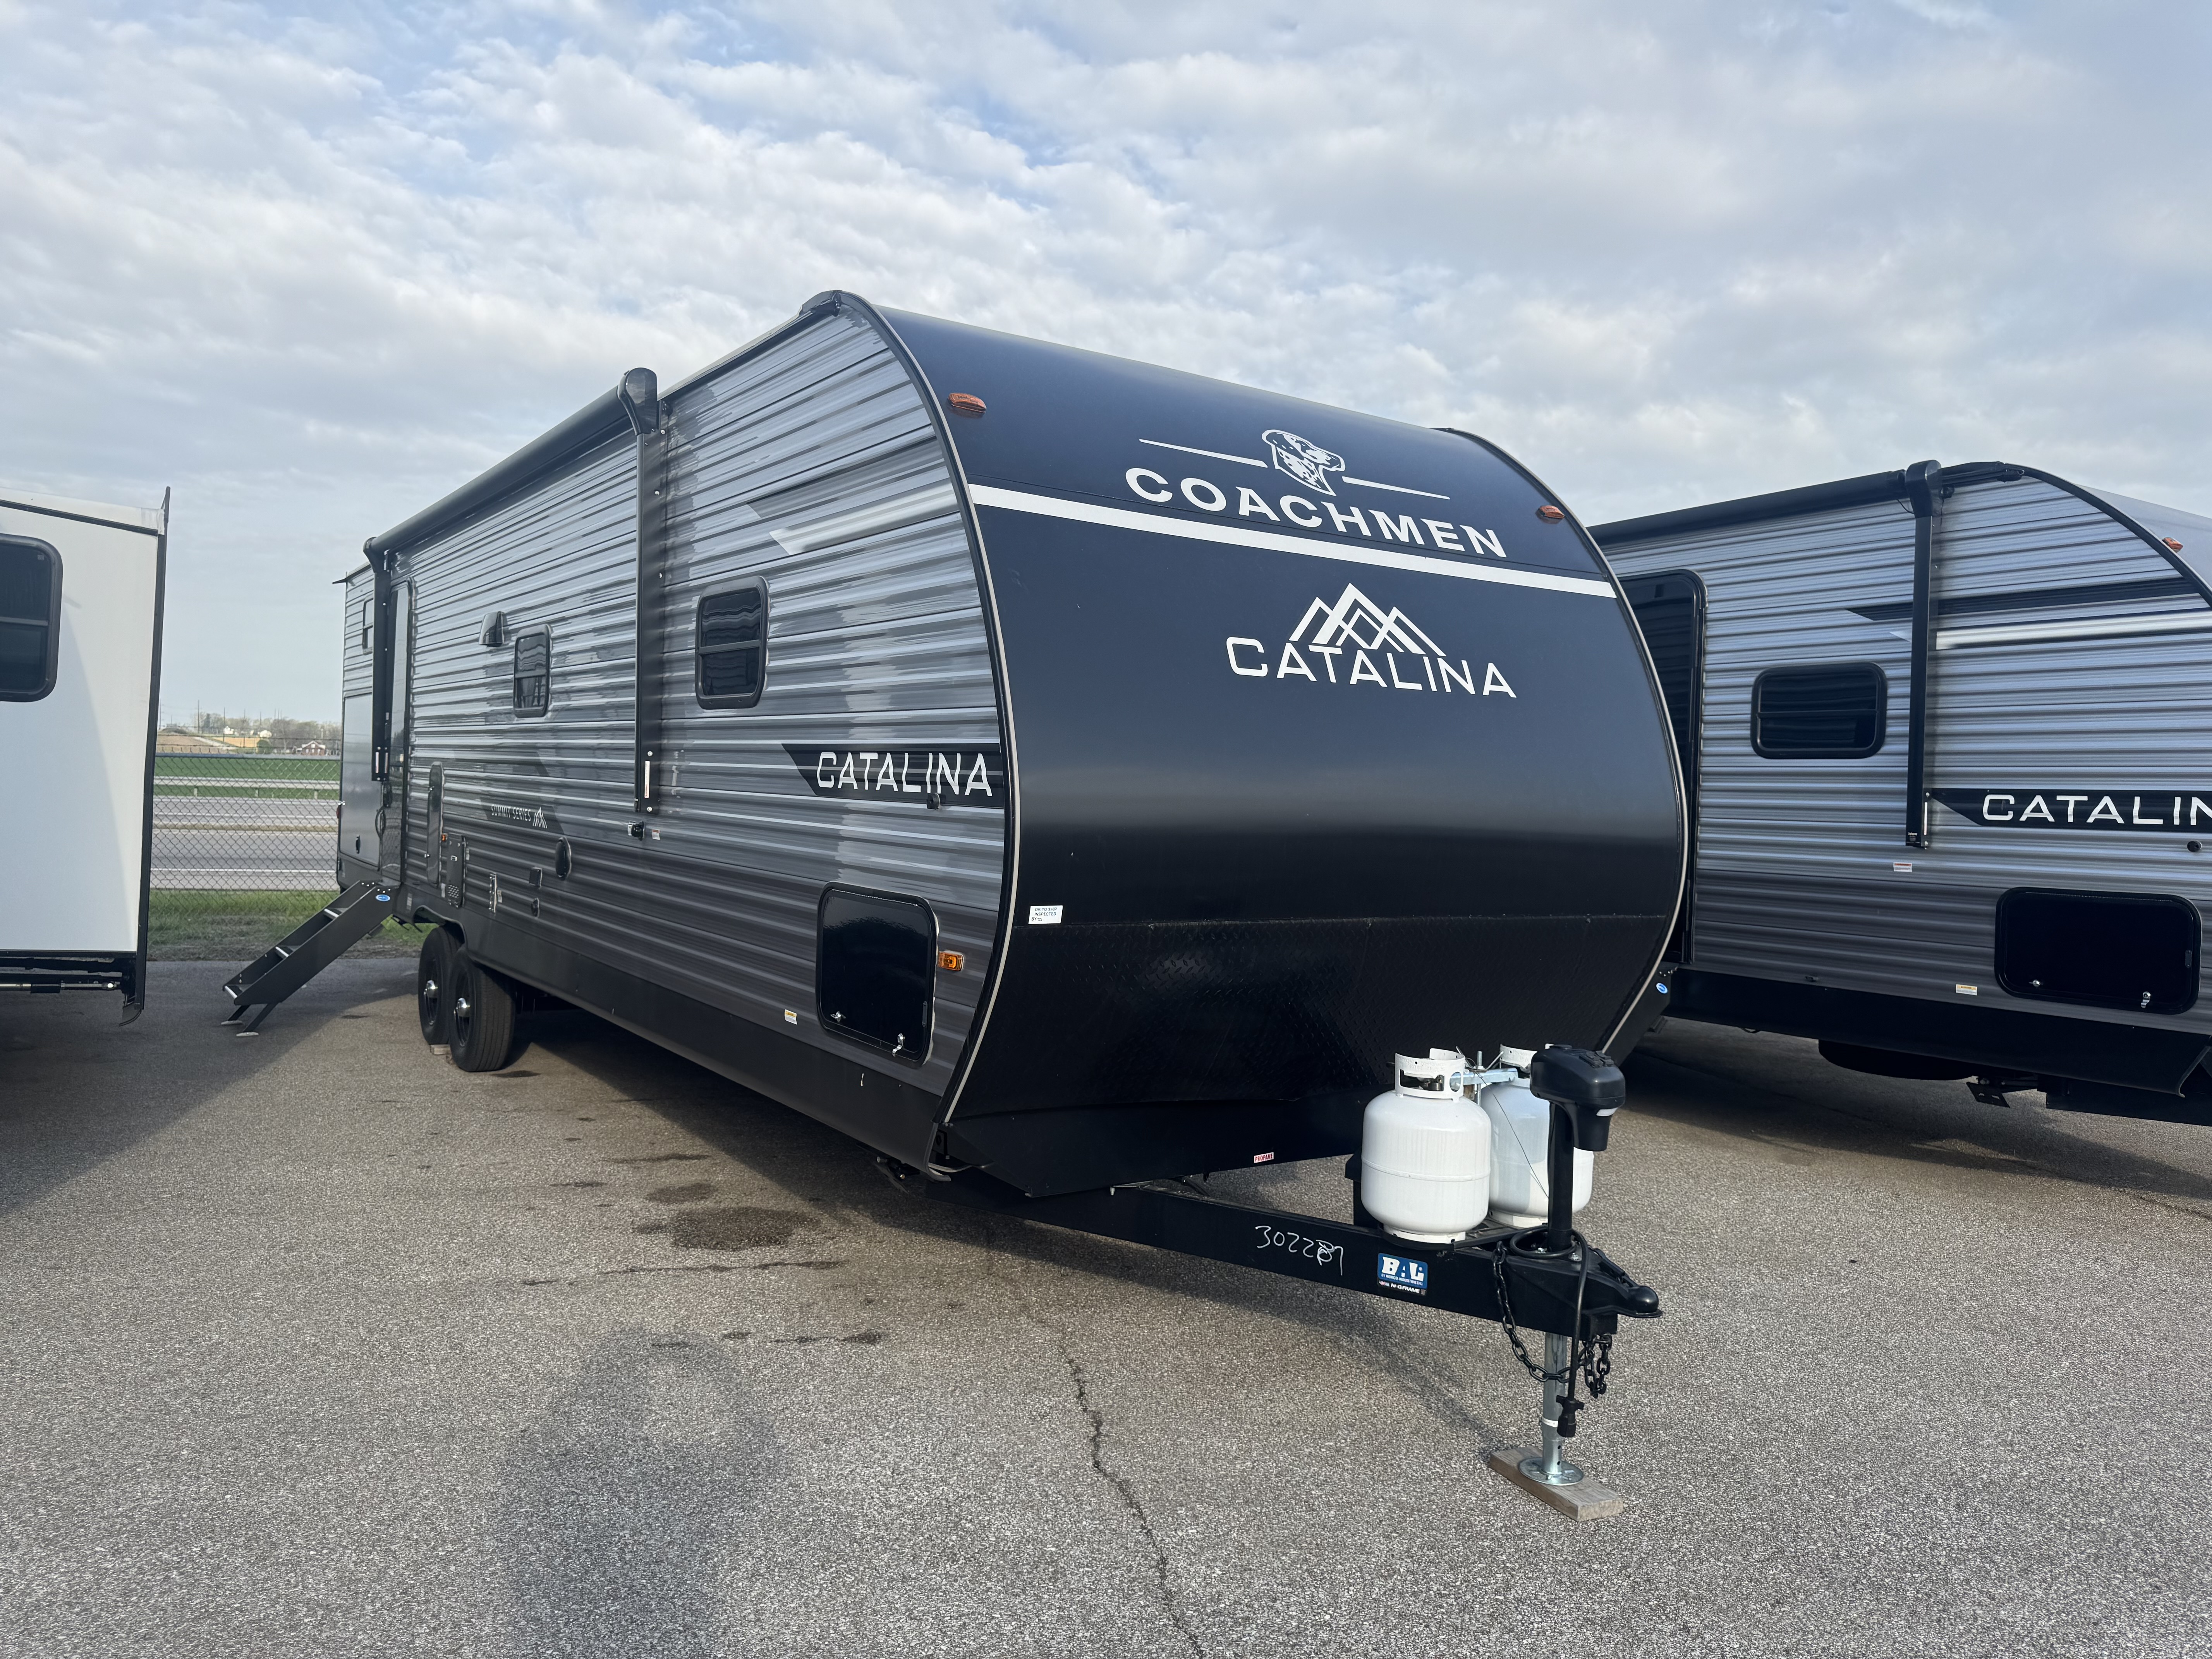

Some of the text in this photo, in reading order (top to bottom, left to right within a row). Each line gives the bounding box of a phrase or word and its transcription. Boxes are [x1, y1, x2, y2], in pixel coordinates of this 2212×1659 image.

[1125, 467, 1507, 558] COACHMEN
[1226, 636, 1517, 698] CATALINA
[817, 752, 992, 797] CATALINA
[491, 804, 531, 821] SUMMIT SERIES
[1983, 794, 2212, 826] CATALIN
[1255, 1153, 1273, 1161] PROPANE
[1381, 1256, 1424, 1281] BAL
